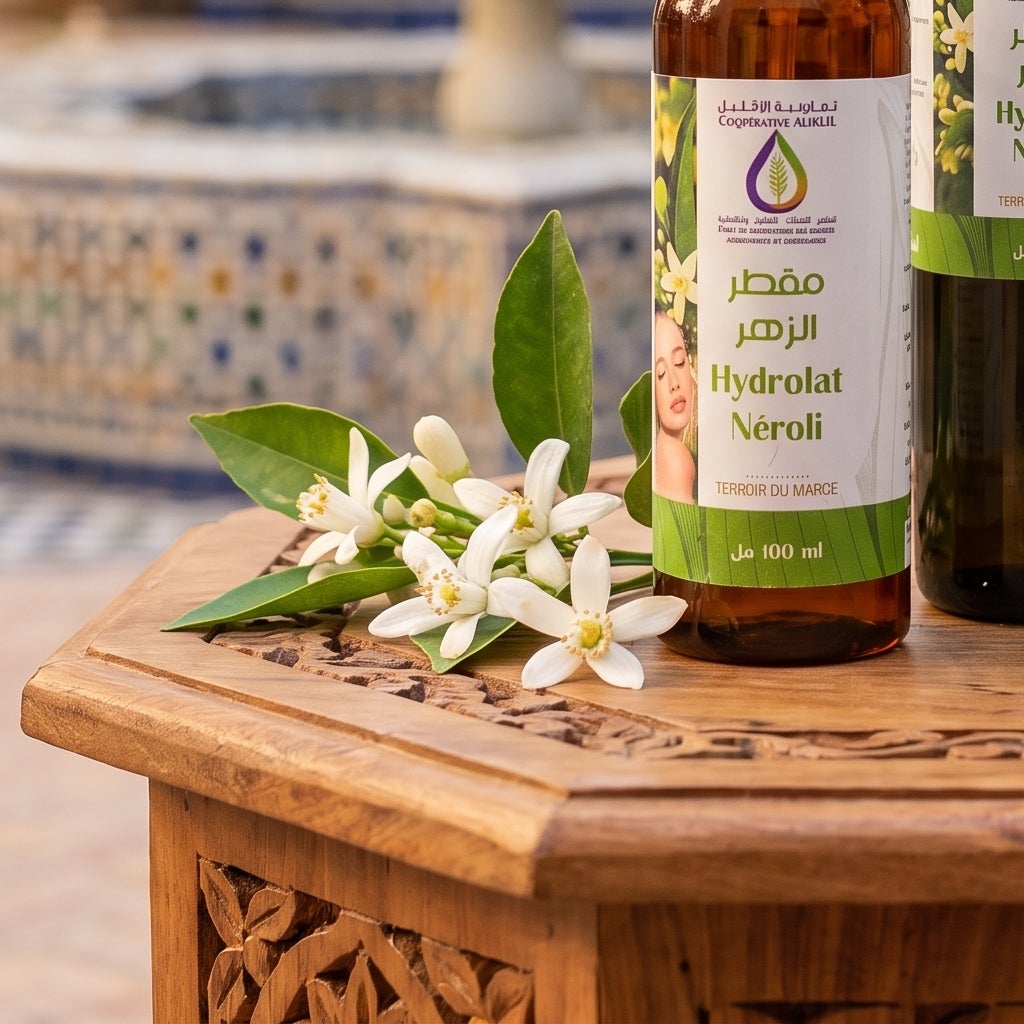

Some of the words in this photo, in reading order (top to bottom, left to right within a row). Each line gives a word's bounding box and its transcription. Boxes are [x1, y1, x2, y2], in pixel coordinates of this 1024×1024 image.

[728, 268, 825, 303] مقطر
[736, 314, 817, 351] الزهر
[712, 365, 844, 402] Hydrolat
[733, 412, 822, 441] Néroli
[716, 482, 767, 497] TERROIR
[771, 484, 789, 497] DU
[794, 482, 839, 497] MARCE
[762, 543, 794, 560] 100
[801, 541, 823, 559] ml
